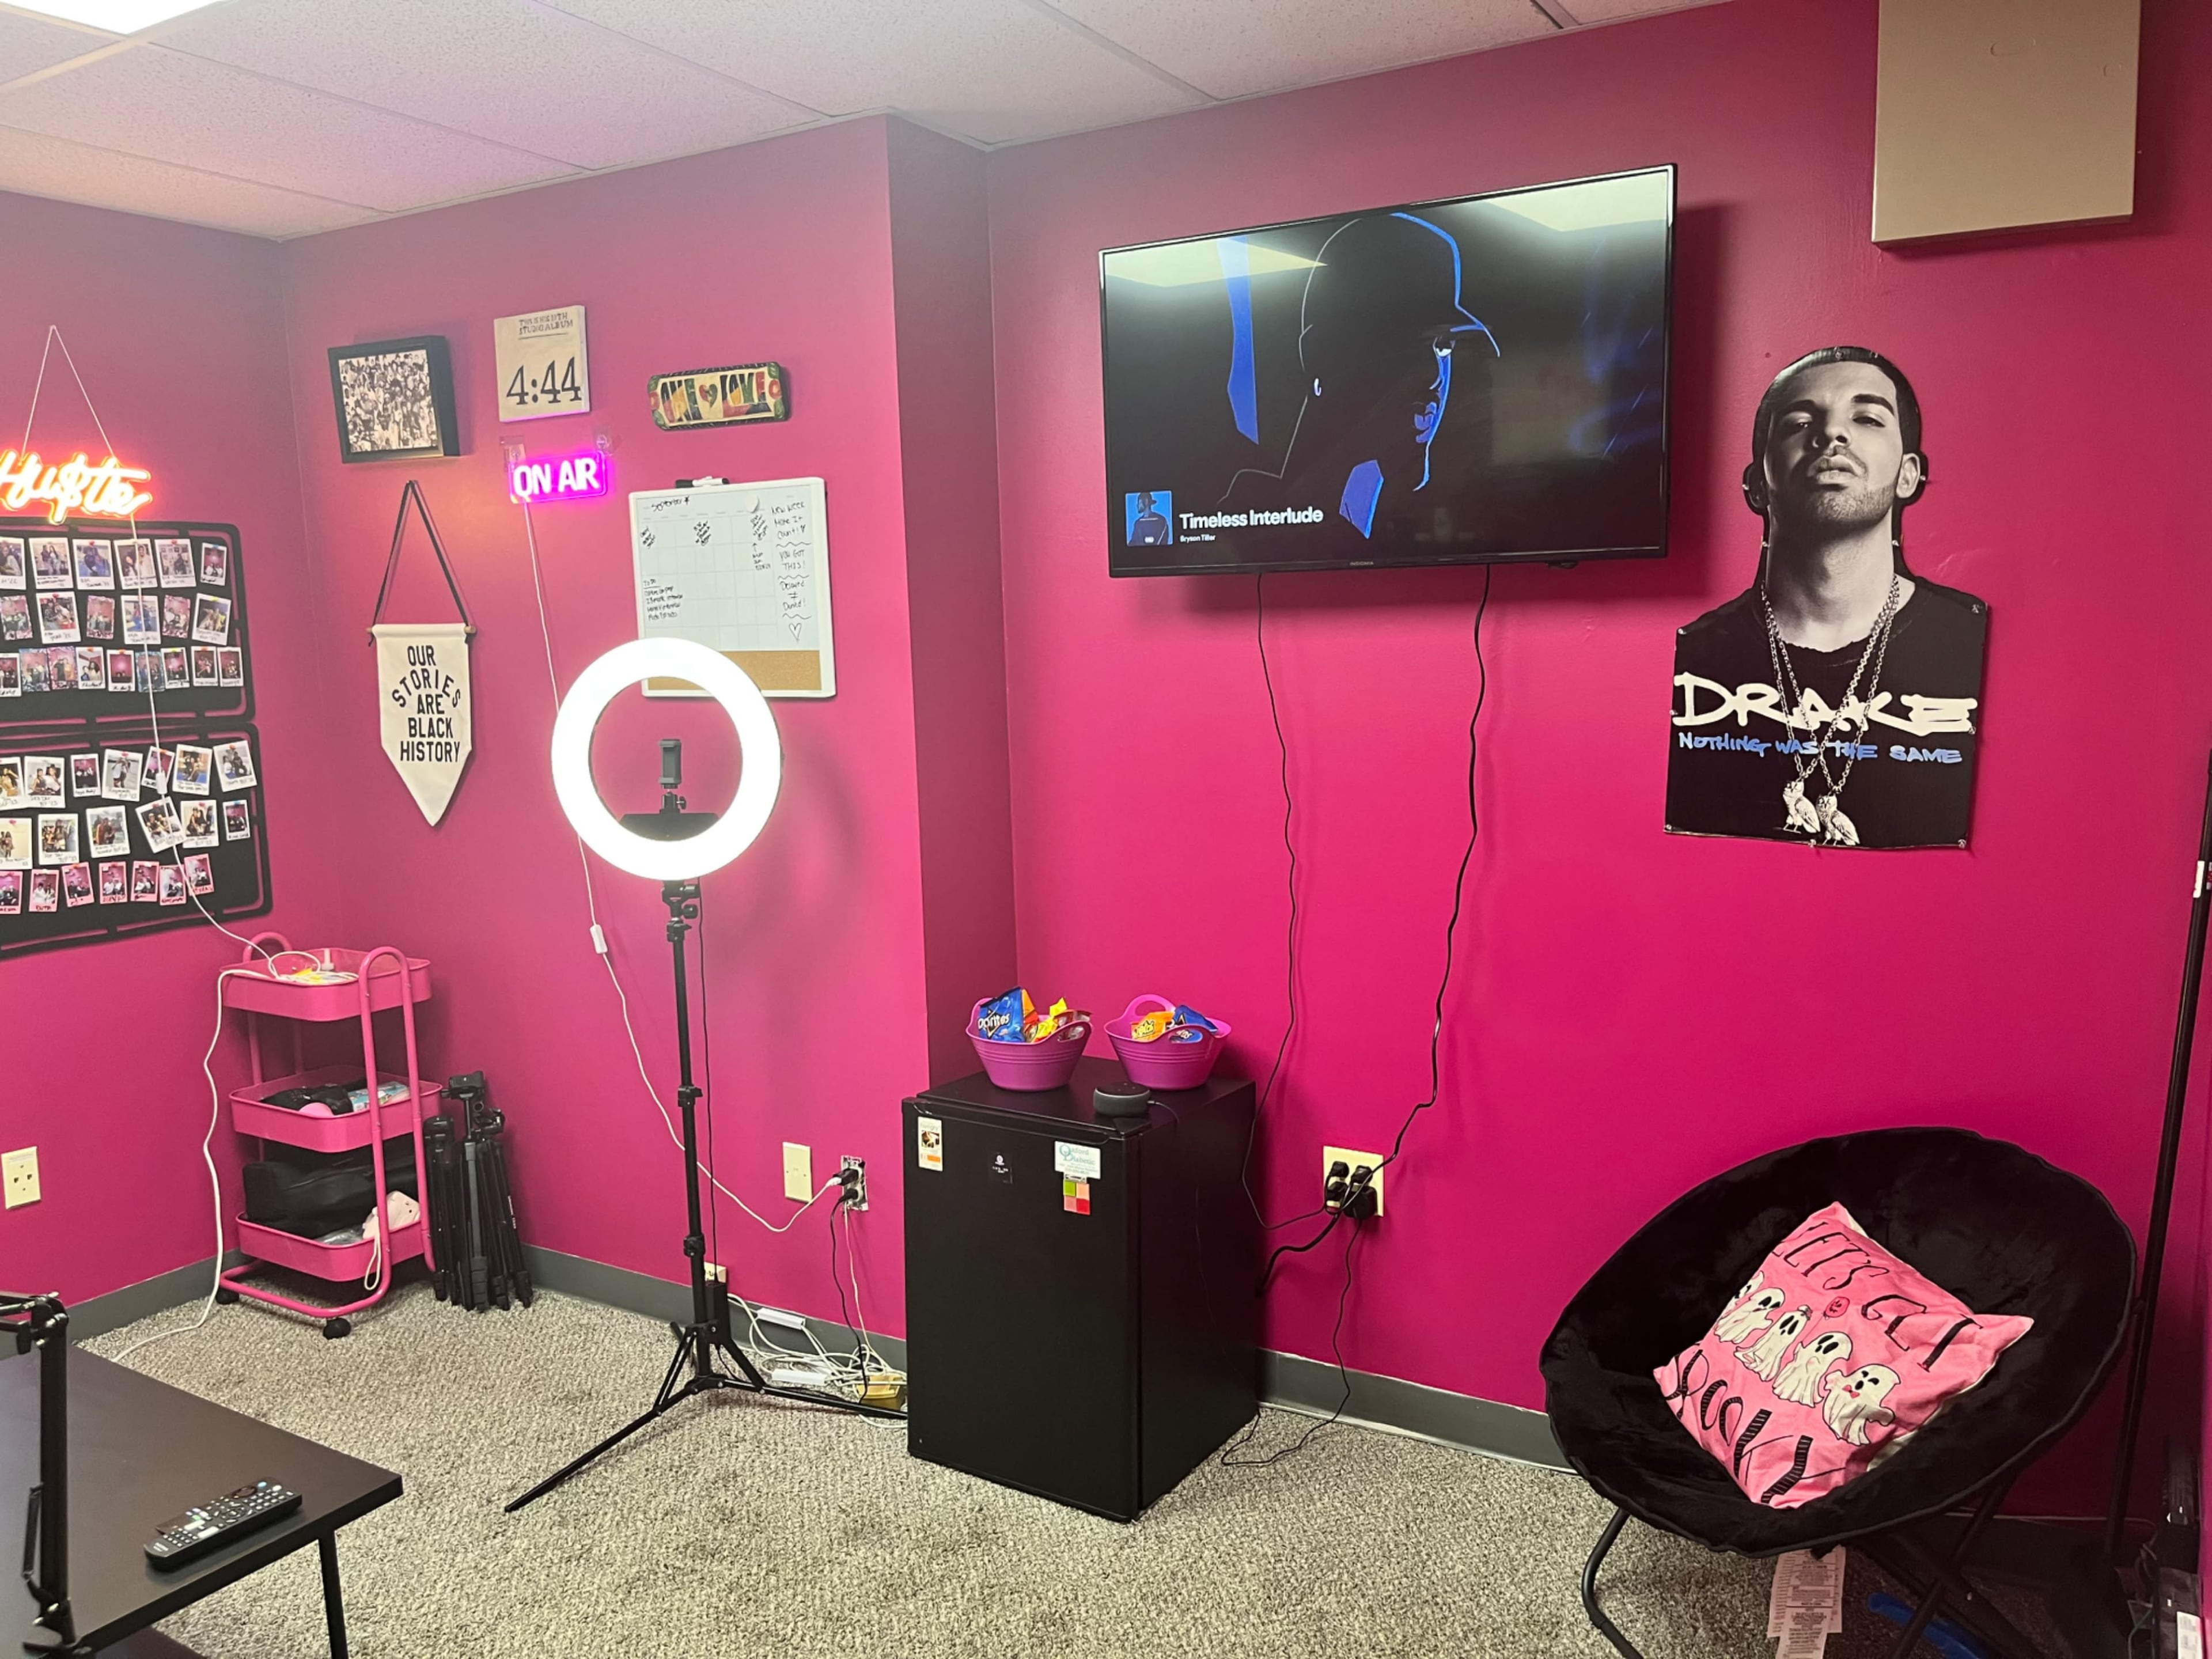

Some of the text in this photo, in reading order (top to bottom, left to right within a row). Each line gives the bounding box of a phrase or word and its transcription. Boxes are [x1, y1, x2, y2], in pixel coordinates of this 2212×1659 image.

[544, 319, 574, 331] ALBUM
[506, 356, 582, 405] 4:44
[719, 371, 773, 418] LOVE
[513, 457, 600, 498] ON AIR
[1179, 506, 1324, 529] Timeless Interlude
[1180, 535, 1200, 543] Bryson
[407, 645, 437, 666] OUR
[392, 668, 461, 709] STORIES
[417, 694, 445, 715] ARE
[1672, 672, 1978, 737] DRAKE
[408, 717, 454, 738] BLACK
[400, 741, 460, 763] HISTORY
[1679, 732, 1963, 764] NOTHING WAS THE SAME
[978, 1013, 1010, 1029] Doritos
